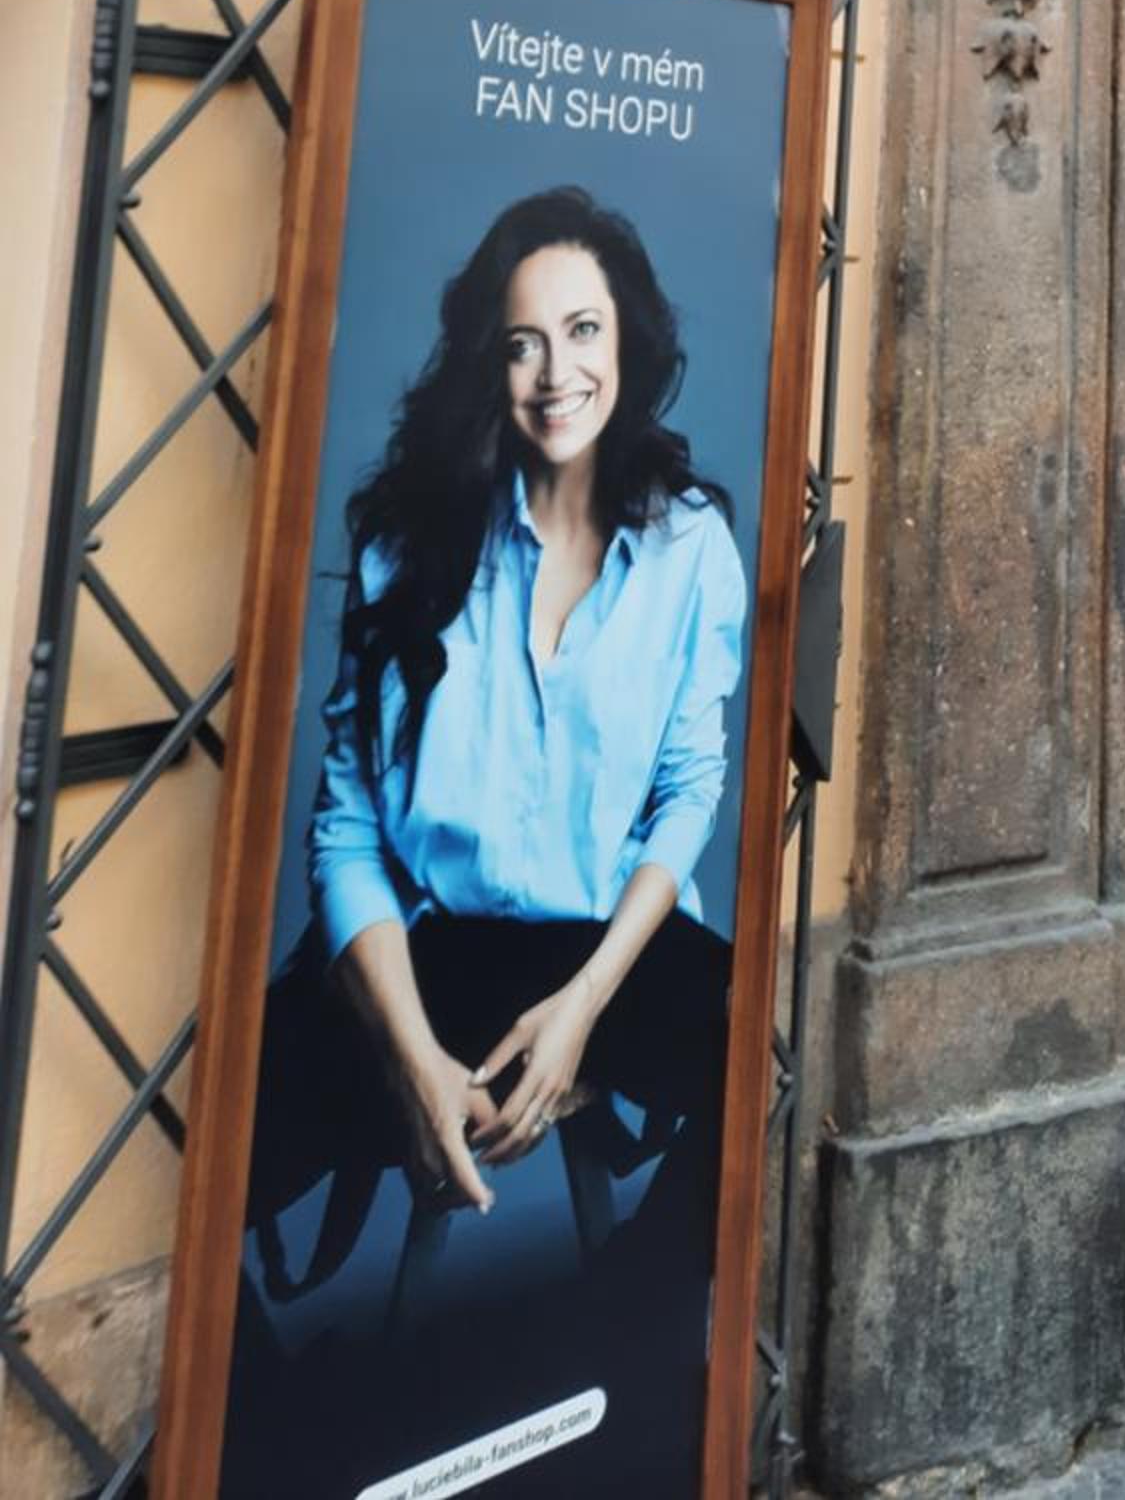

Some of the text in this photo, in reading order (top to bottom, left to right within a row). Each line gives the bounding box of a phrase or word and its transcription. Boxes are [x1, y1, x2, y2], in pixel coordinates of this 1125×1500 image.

[471, 19, 704, 92] Vítejte v mém
[476, 76, 693, 141] FAN SHOPU
